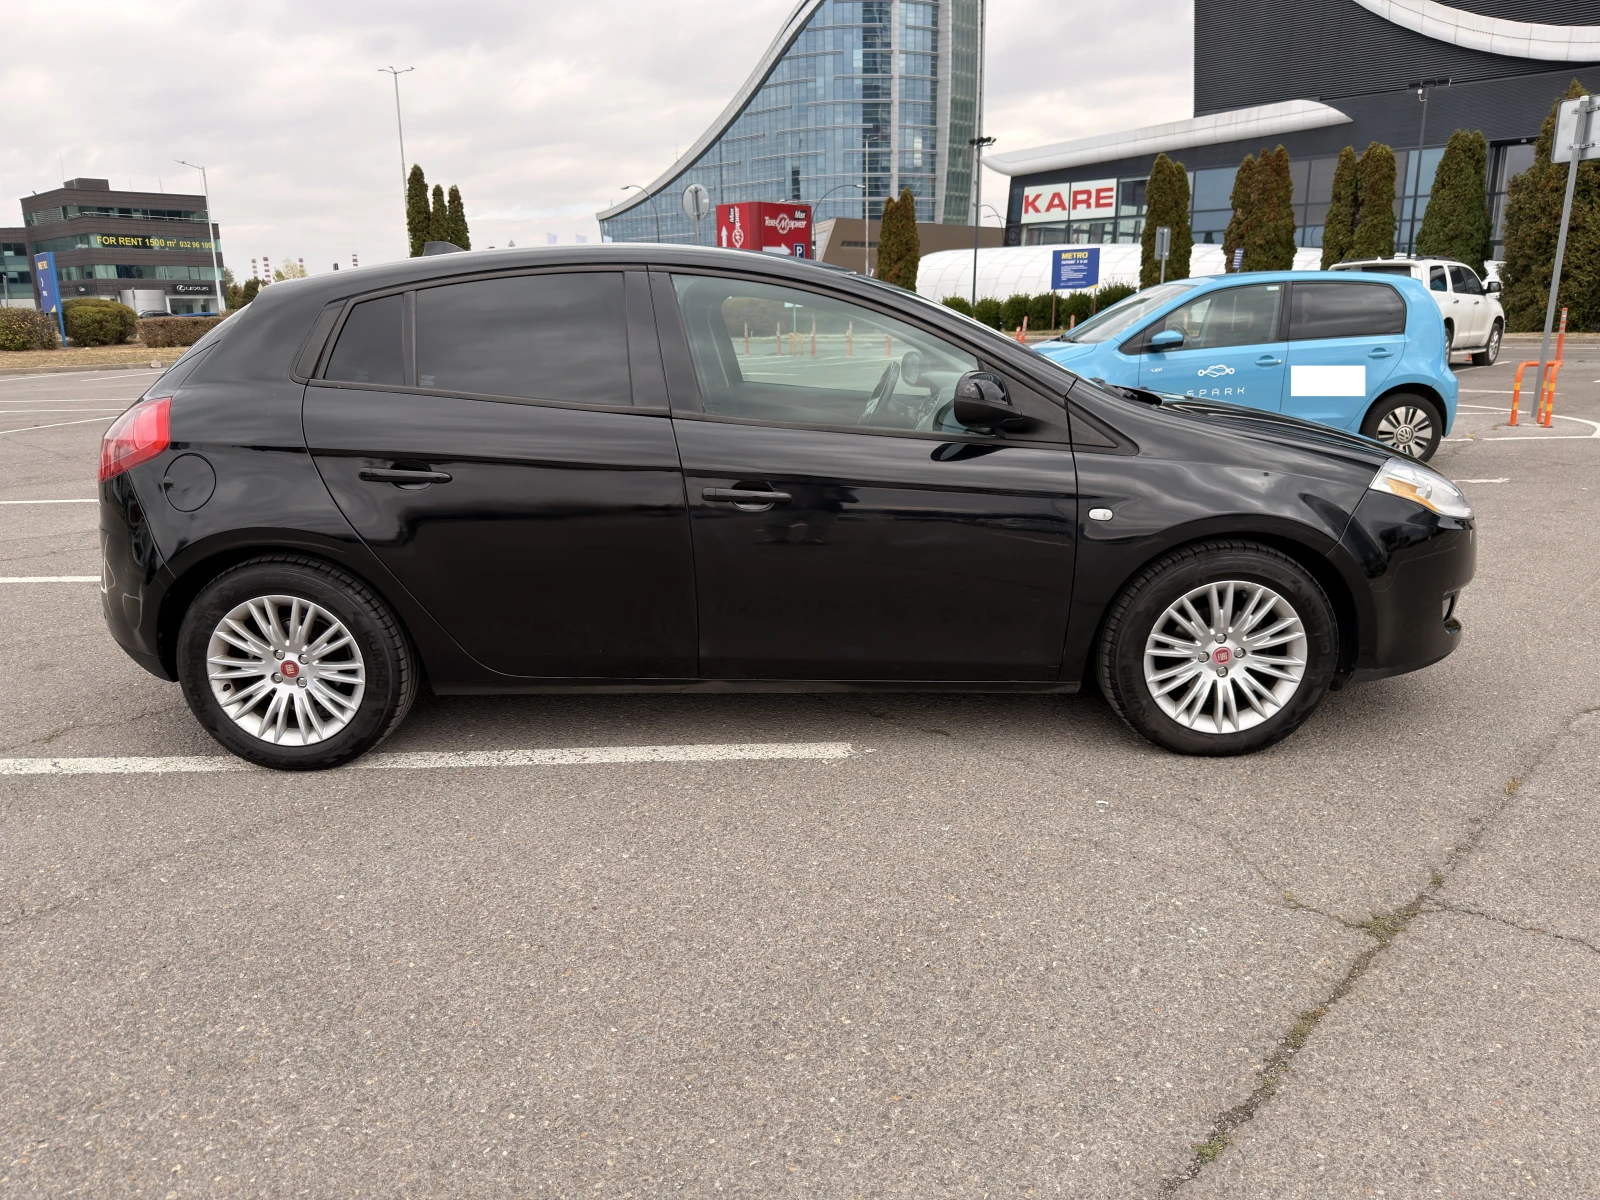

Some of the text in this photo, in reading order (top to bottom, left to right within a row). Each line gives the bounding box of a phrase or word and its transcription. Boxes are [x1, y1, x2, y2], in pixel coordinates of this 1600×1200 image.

[1023, 187, 1114, 215] KARE
[794, 210, 806, 219] Max
[96, 236, 117, 245] FOR
[118, 237, 142, 246] RENT
[145, 238, 165, 247] 1500
[1061, 252, 1088, 260] METRO
[1186, 387, 1245, 397] SPARK
